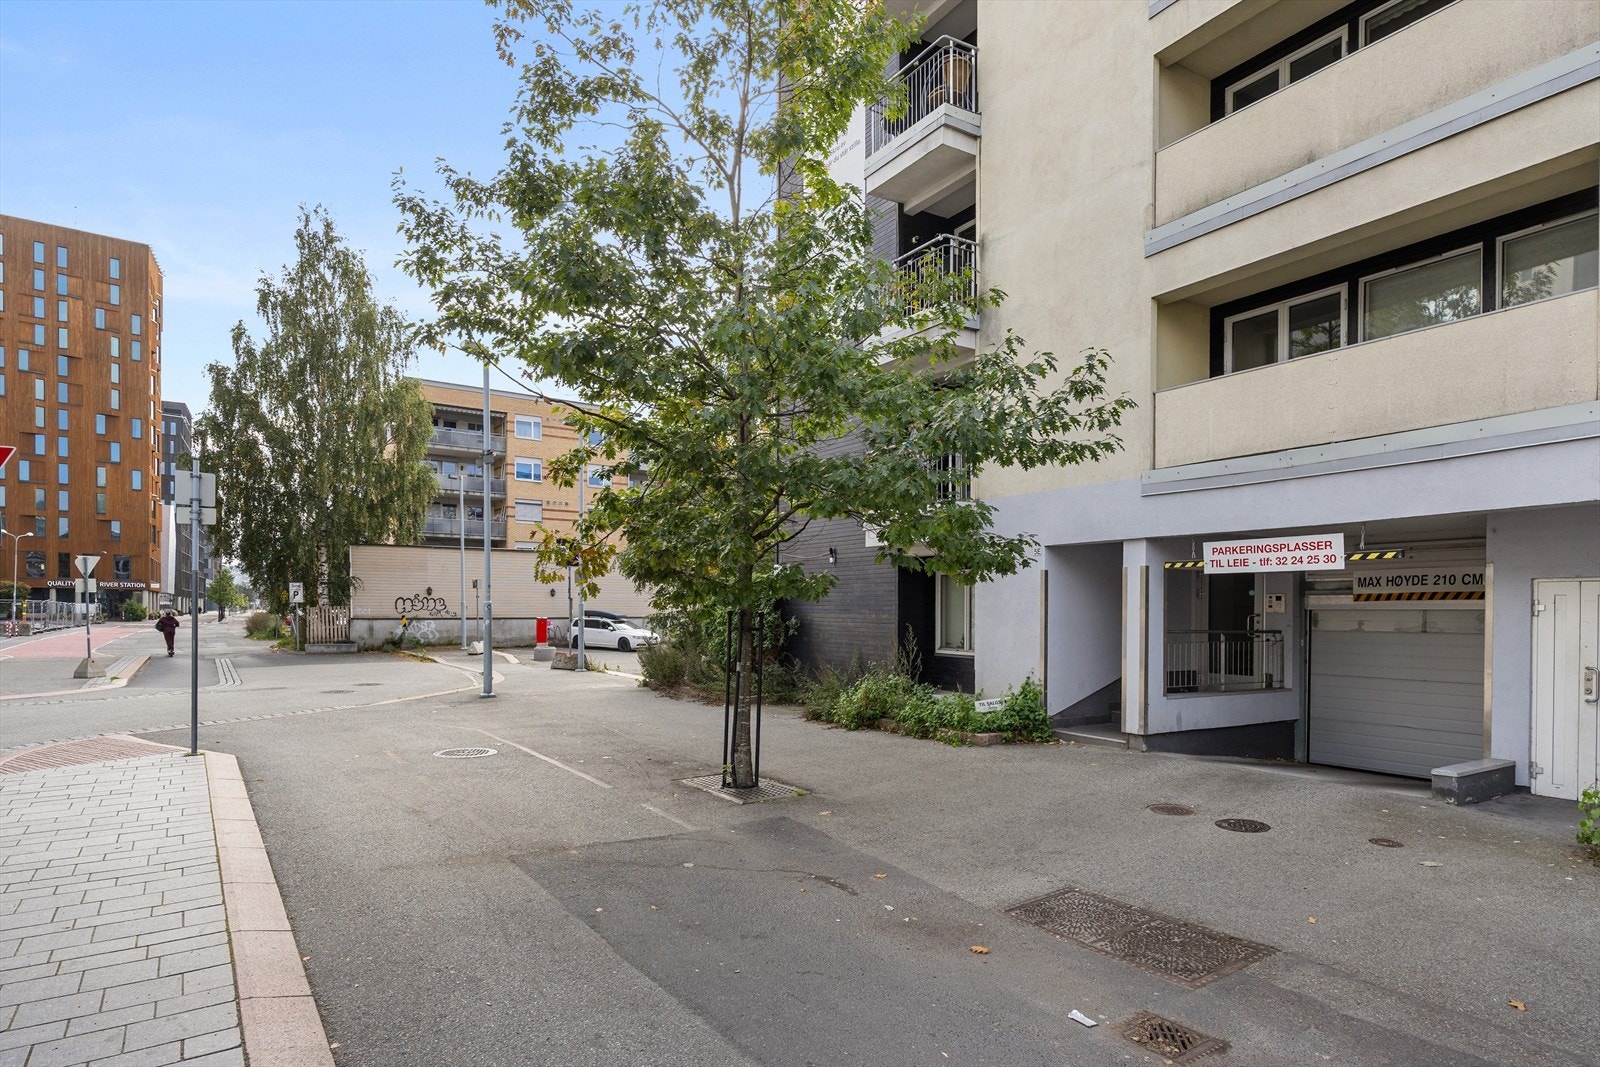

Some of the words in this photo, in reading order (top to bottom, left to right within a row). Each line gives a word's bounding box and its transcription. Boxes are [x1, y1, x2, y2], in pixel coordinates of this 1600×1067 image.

[1211, 540, 1333, 556] PARKERINGSPLASSER
[1209, 559, 1226, 569] TIL
[1226, 558, 1250, 568] LEIE
[1259, 557, 1273, 567] tlf:
[1275, 556, 1288, 567] 32
[1291, 555, 1304, 566] 24
[1307, 554, 1321, 565] 25
[1323, 554, 1337, 564] 30
[1357, 576, 1382, 588] MAX
[1386, 574, 1429, 588] HØYDE
[1433, 574, 1457, 586] 210
[1461, 573, 1484, 585] CM
[293, 590, 299, 599] P
